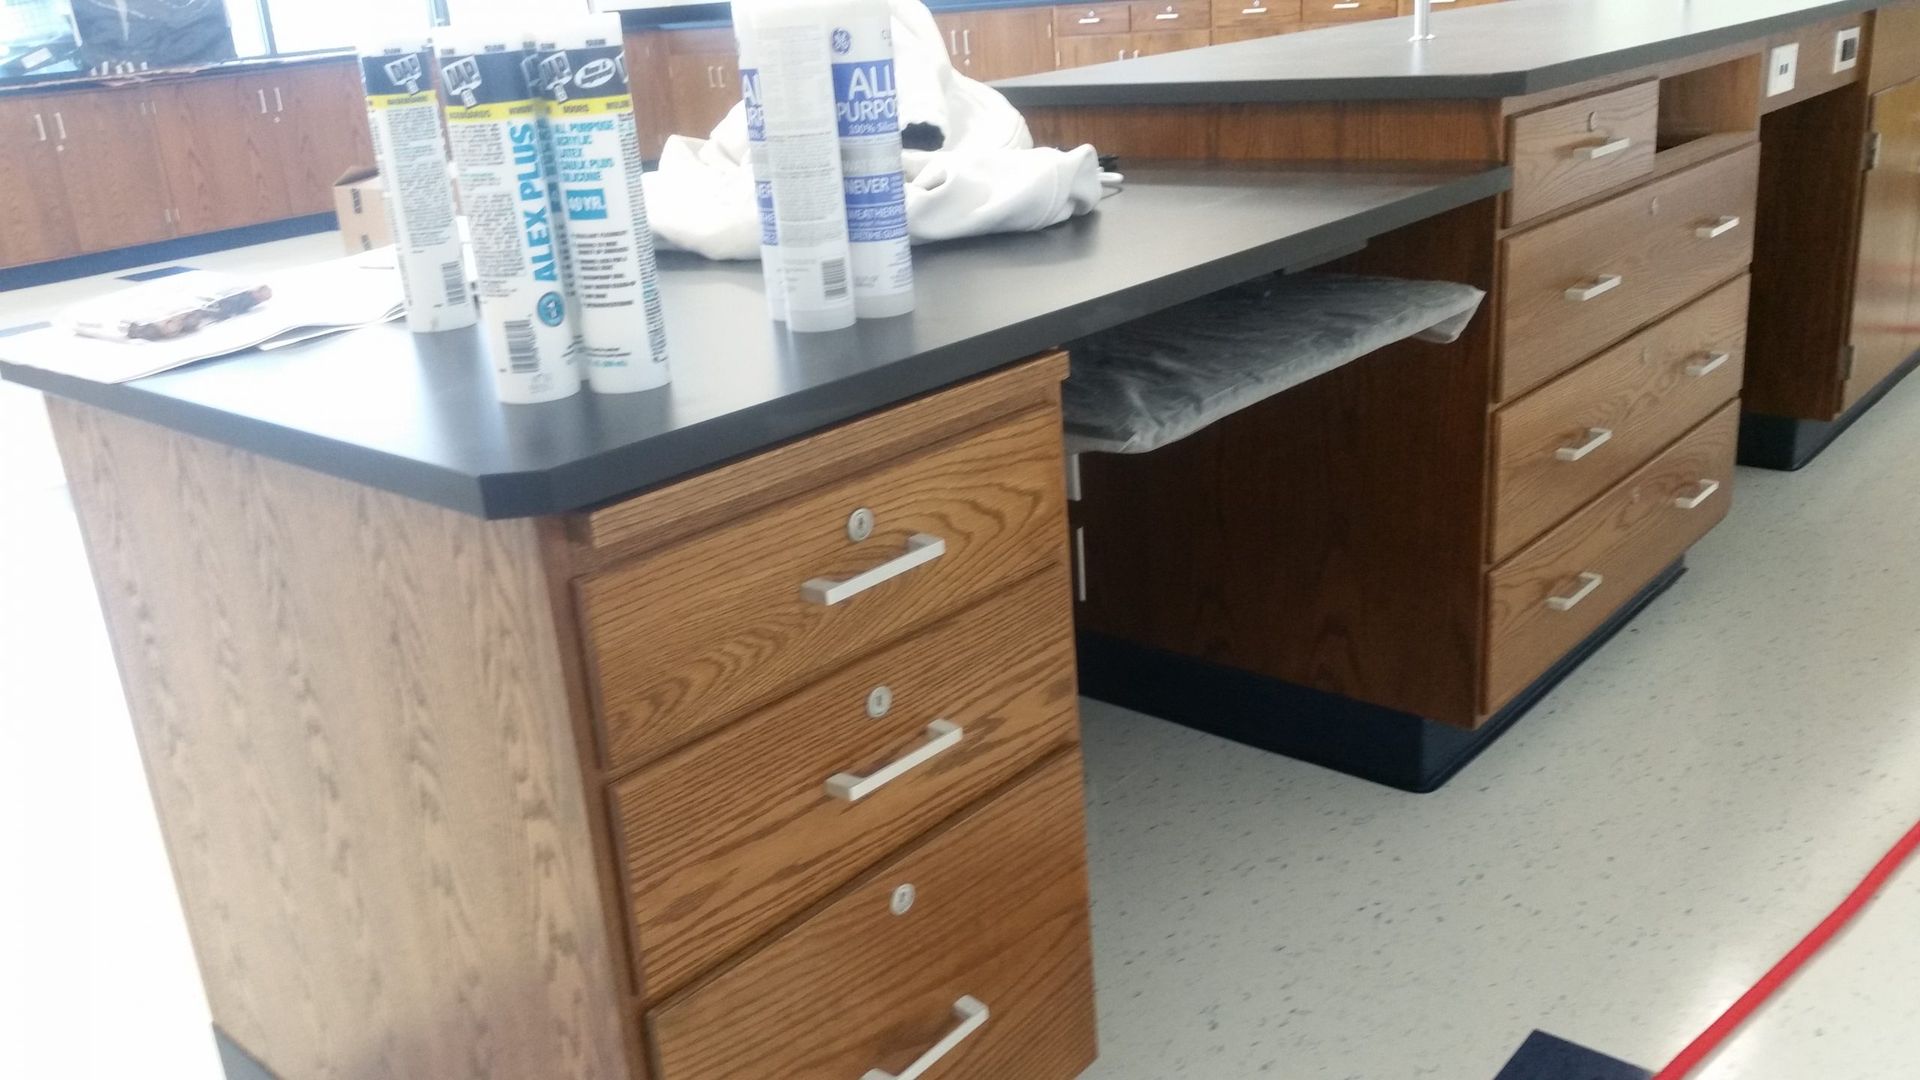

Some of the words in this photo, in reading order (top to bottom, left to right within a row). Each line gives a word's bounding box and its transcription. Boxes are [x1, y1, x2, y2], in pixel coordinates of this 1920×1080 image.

[389, 57, 420, 82] DAP
[446, 60, 479, 91] DAP
[848, 64, 897, 101] ALL
[837, 98, 898, 122] PURPO
[509, 122, 544, 201] PLUS
[523, 206, 558, 282] ALEX
